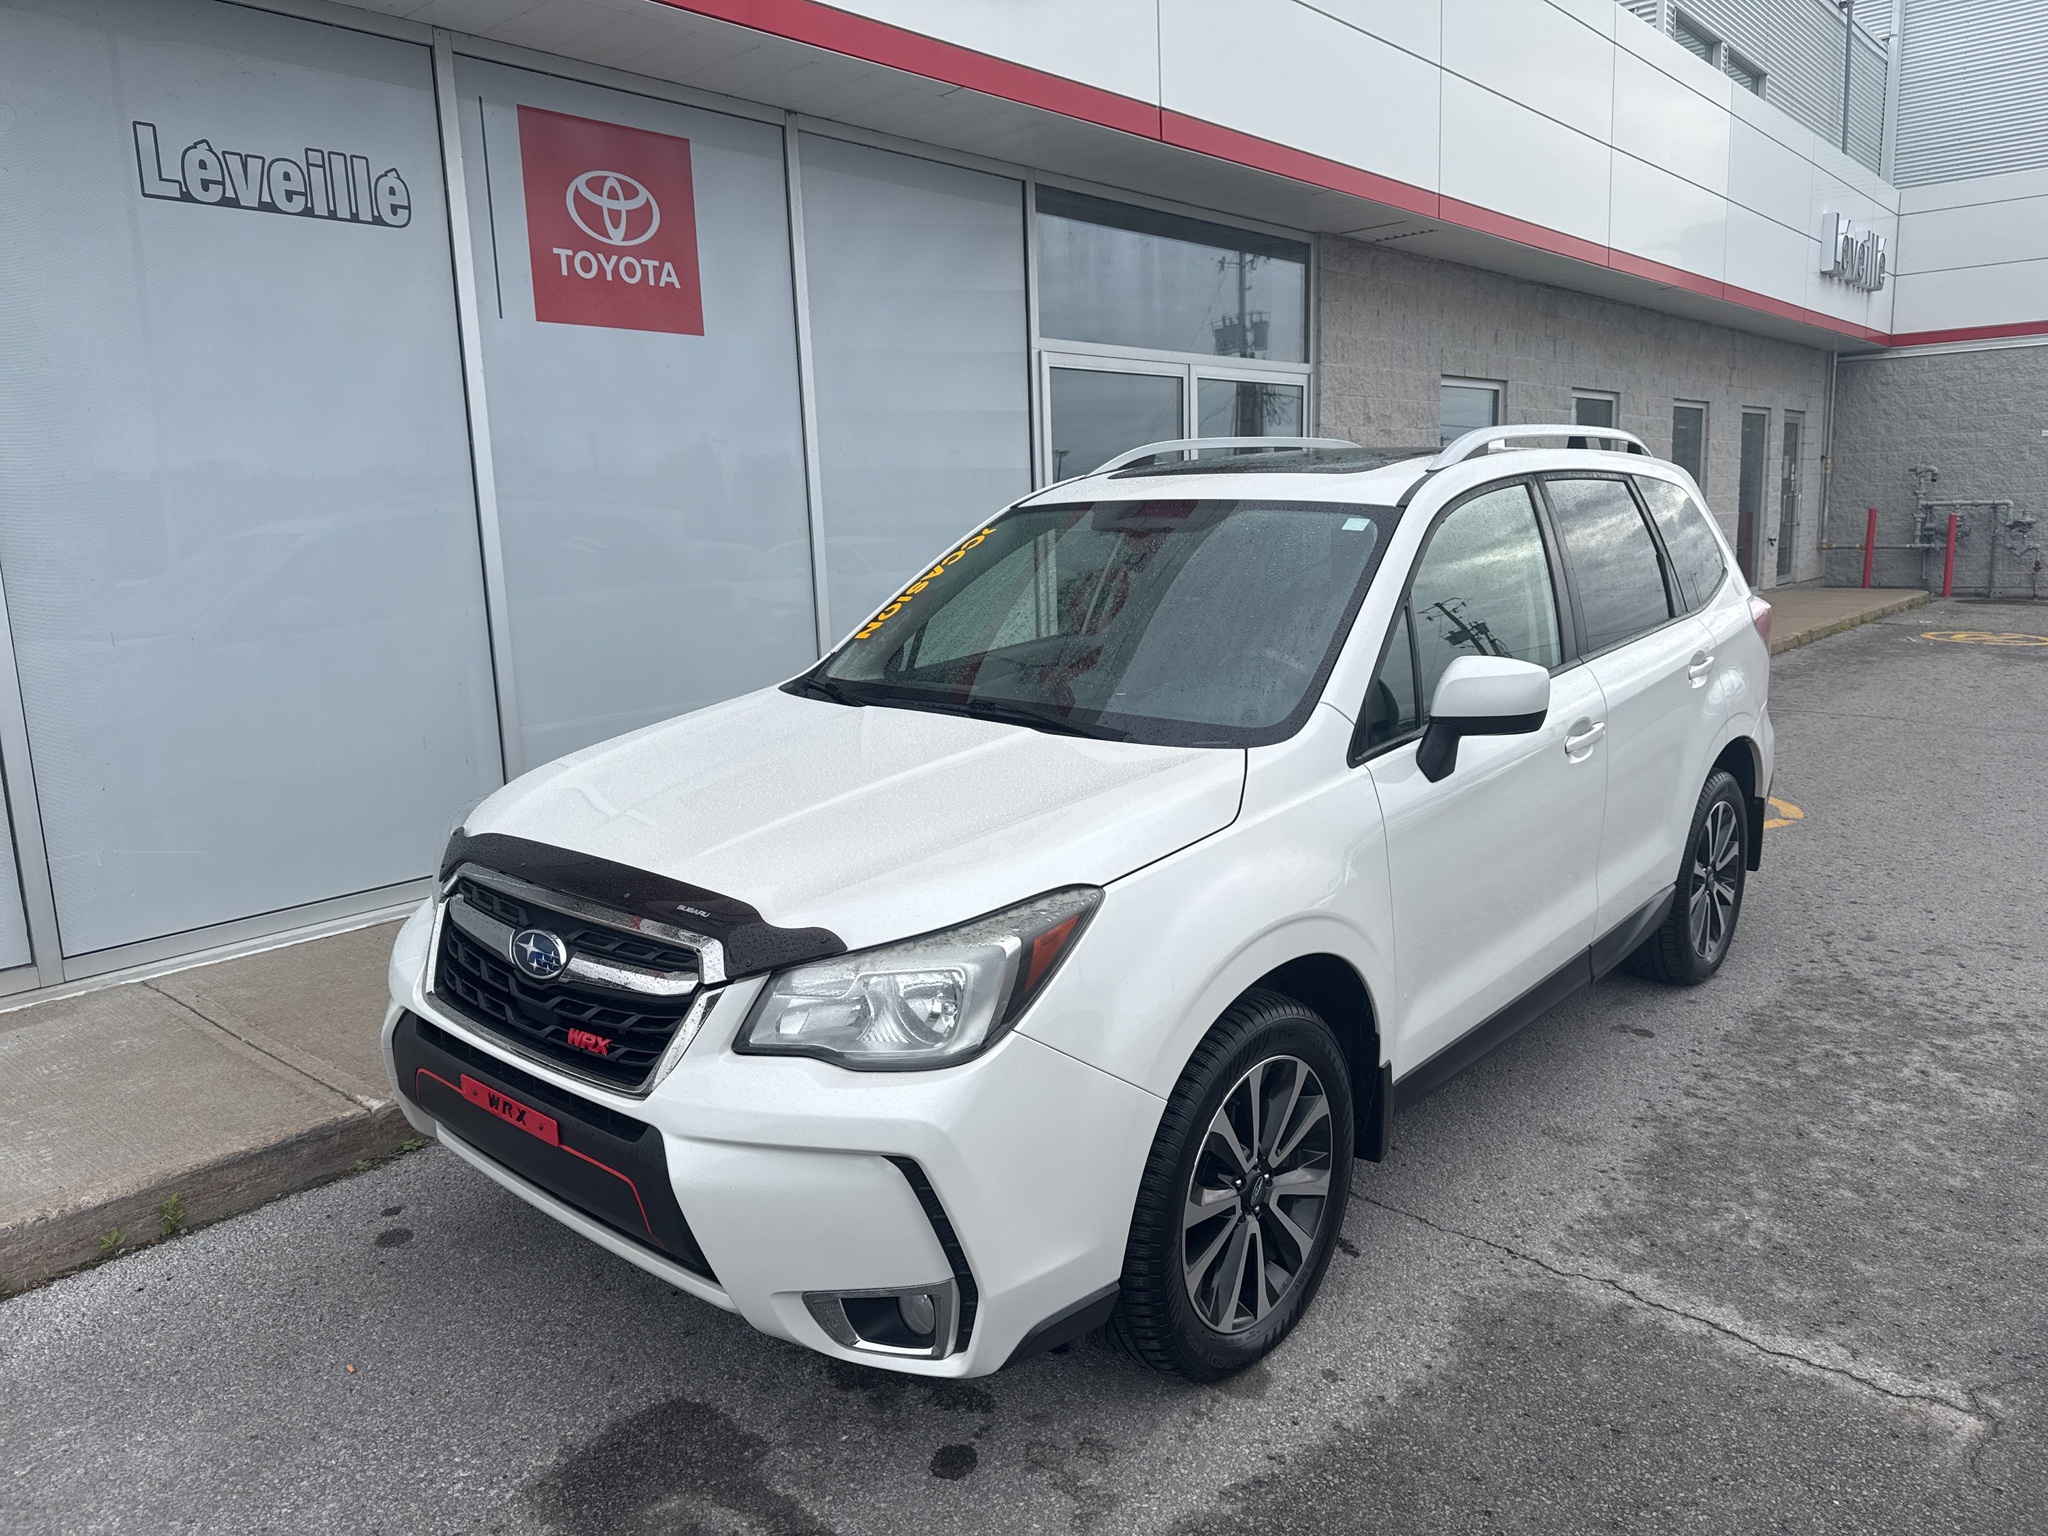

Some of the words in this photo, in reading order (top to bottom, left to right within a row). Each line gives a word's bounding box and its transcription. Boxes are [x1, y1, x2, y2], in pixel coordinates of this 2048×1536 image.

[132, 120, 412, 229] Léveillé
[552, 246, 682, 290] TOYOTA
[676, 903, 711, 918] SUBARU
[567, 1027, 613, 1057] WRX
[486, 1091, 528, 1127] WRX
